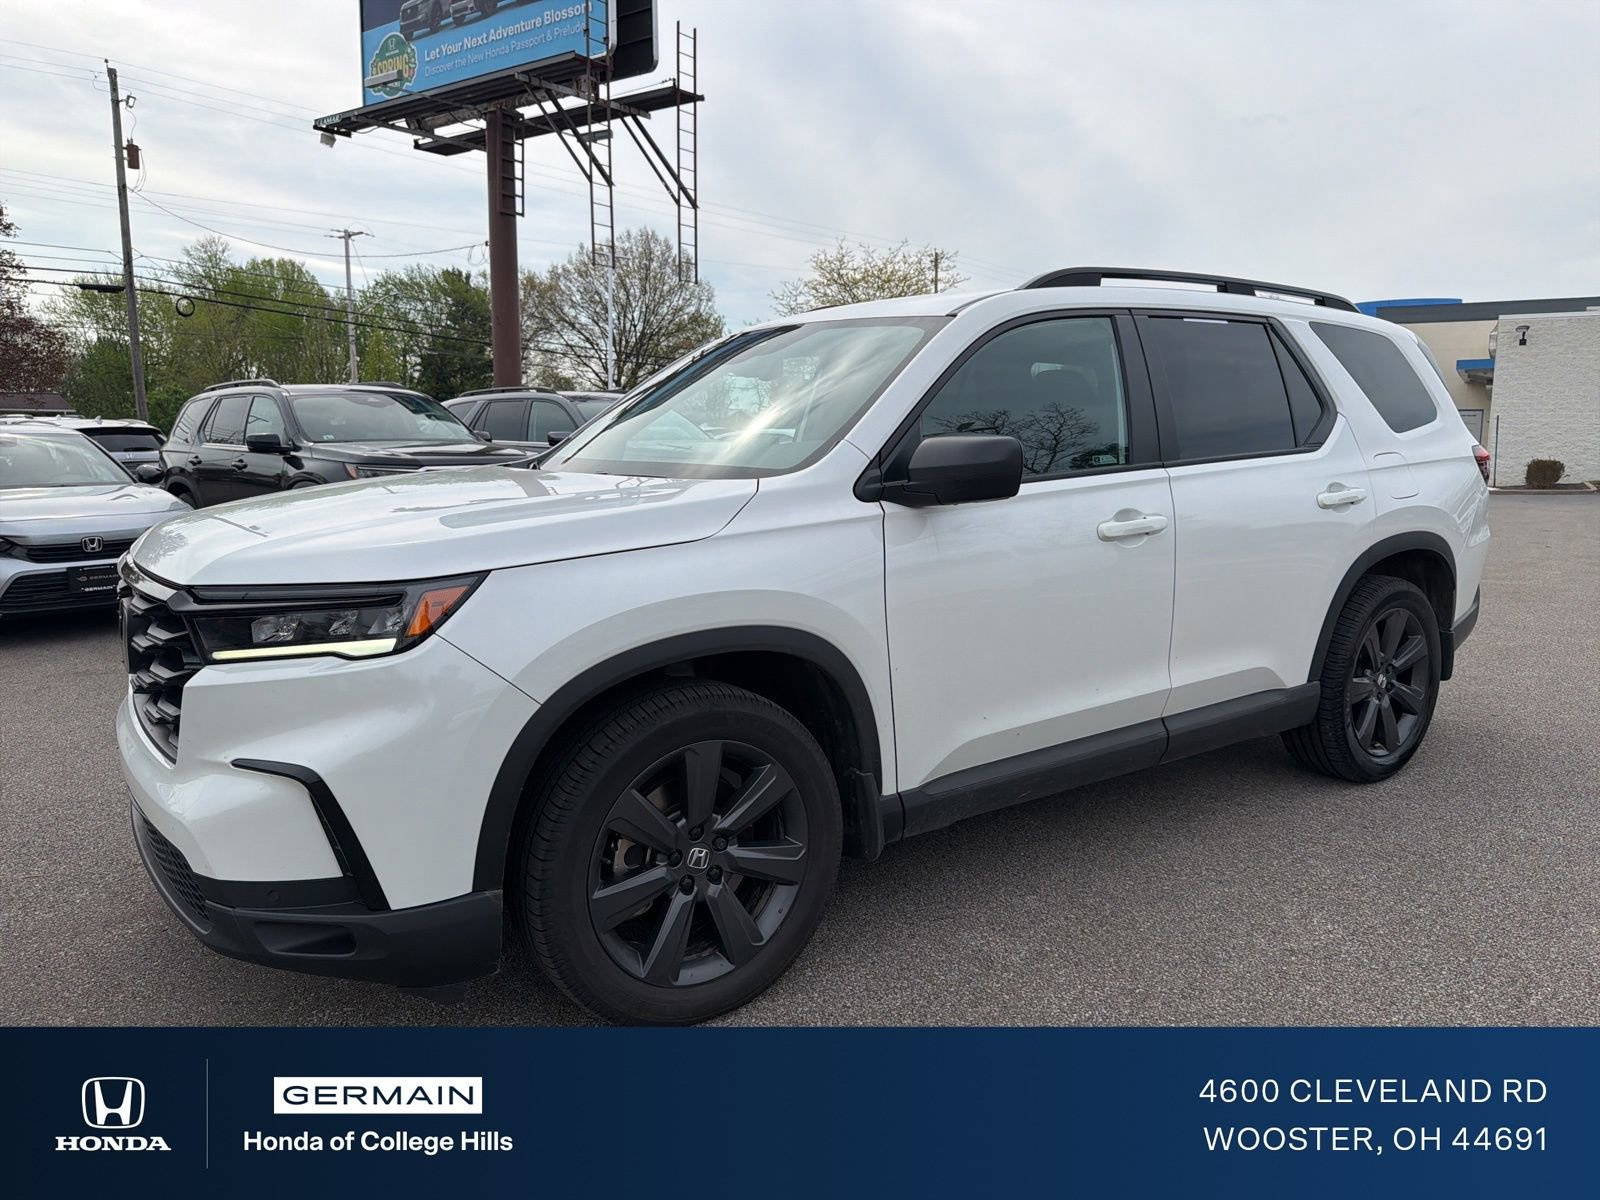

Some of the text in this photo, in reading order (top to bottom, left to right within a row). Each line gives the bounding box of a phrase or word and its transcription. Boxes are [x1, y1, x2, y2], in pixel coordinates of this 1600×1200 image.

[424, 47, 440, 61] Let
[441, 38, 462, 56] Your
[463, 31, 488, 50] Next
[489, 16, 542, 42] Adventure
[424, 21, 585, 77] Discover the New Honda Passport & Prelude
